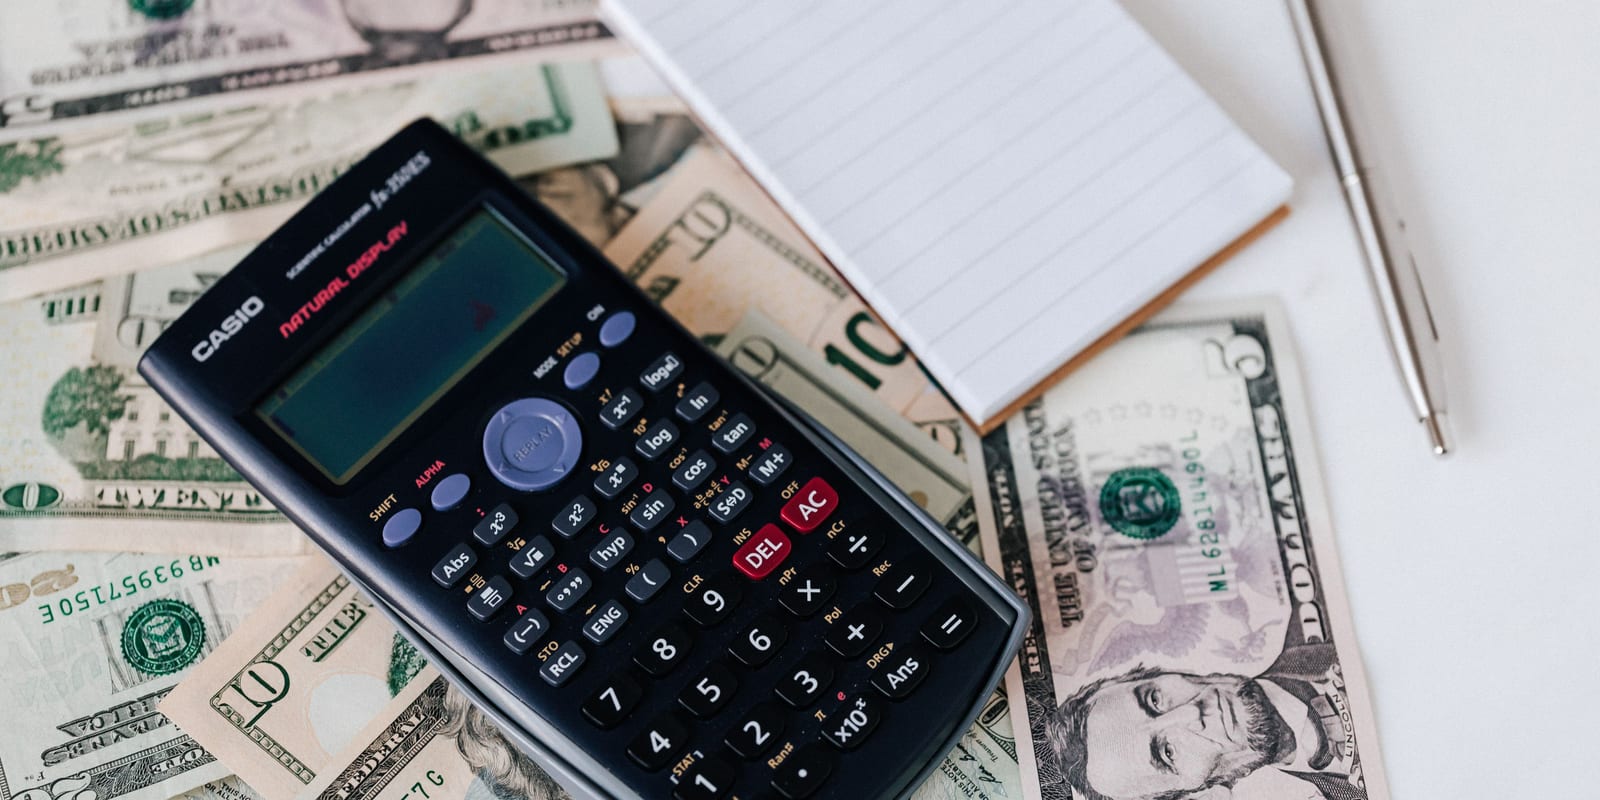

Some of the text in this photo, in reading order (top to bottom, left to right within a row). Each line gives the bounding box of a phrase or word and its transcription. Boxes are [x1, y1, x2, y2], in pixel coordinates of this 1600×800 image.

[279, 220, 409, 338] NATURAL DISPLAY
[586, 304, 605, 321] ON
[191, 296, 265, 363] CASIO
[533, 355, 558, 380] MODE
[513, 426, 552, 462] REPLAY
[645, 428, 672, 450] log
[723, 422, 749, 444] tan
[758, 437, 773, 450] M
[415, 459, 446, 488] ALPHA
[684, 458, 707, 480] cos
[758, 452, 785, 477] M+
[642, 482, 654, 494] D
[781, 480, 800, 500] OFF
[369, 493, 398, 522] SHIFT
[643, 499, 665, 520] sin
[798, 490, 828, 521] AC
[599, 524, 609, 534] C
[826, 519, 846, 539] nCr
[1038, 474, 1073, 568] UNITED
[598, 535, 627, 562] hyp
[733, 527, 752, 546] INS
[442, 552, 470, 578] Abs
[745, 538, 783, 569] DEL
[1073, 545, 1098, 573] OF
[557, 563, 568, 574] B
[778, 566, 797, 586] nPr
[872, 559, 892, 577] Rec
[1206, 562, 1229, 592] ML
[58, 559, 185, 617] 93957150
[683, 574, 704, 594] CLR
[516, 604, 527, 615] A
[702, 590, 725, 612] 9
[1053, 572, 1083, 628] THE
[38, 603, 55, 624] E
[591, 606, 622, 636] ENG
[824, 606, 843, 625] Pol
[652, 638, 676, 661] 8
[749, 628, 771, 651] 6
[537, 641, 559, 663] STO
[550, 652, 579, 677] RCL
[886, 657, 919, 690] Ans
[696, 677, 721, 702] 5
[794, 670, 818, 694] 3
[213, 660, 291, 731] 10
[600, 687, 621, 711] 7
[743, 721, 770, 745] 2
[1331, 692, 1354, 759] LINCOLN
[649, 730, 671, 753] 4
[150, 746, 206, 778] OTE
[335, 710, 427, 800] FEDERAL
[672, 753, 695, 777] STAT
[767, 742, 794, 769] Ran#
[694, 774, 717, 793] 1
[940, 764, 960, 783] NOTE
[958, 782, 974, 798] THIS
[966, 780, 980, 793] ALL
